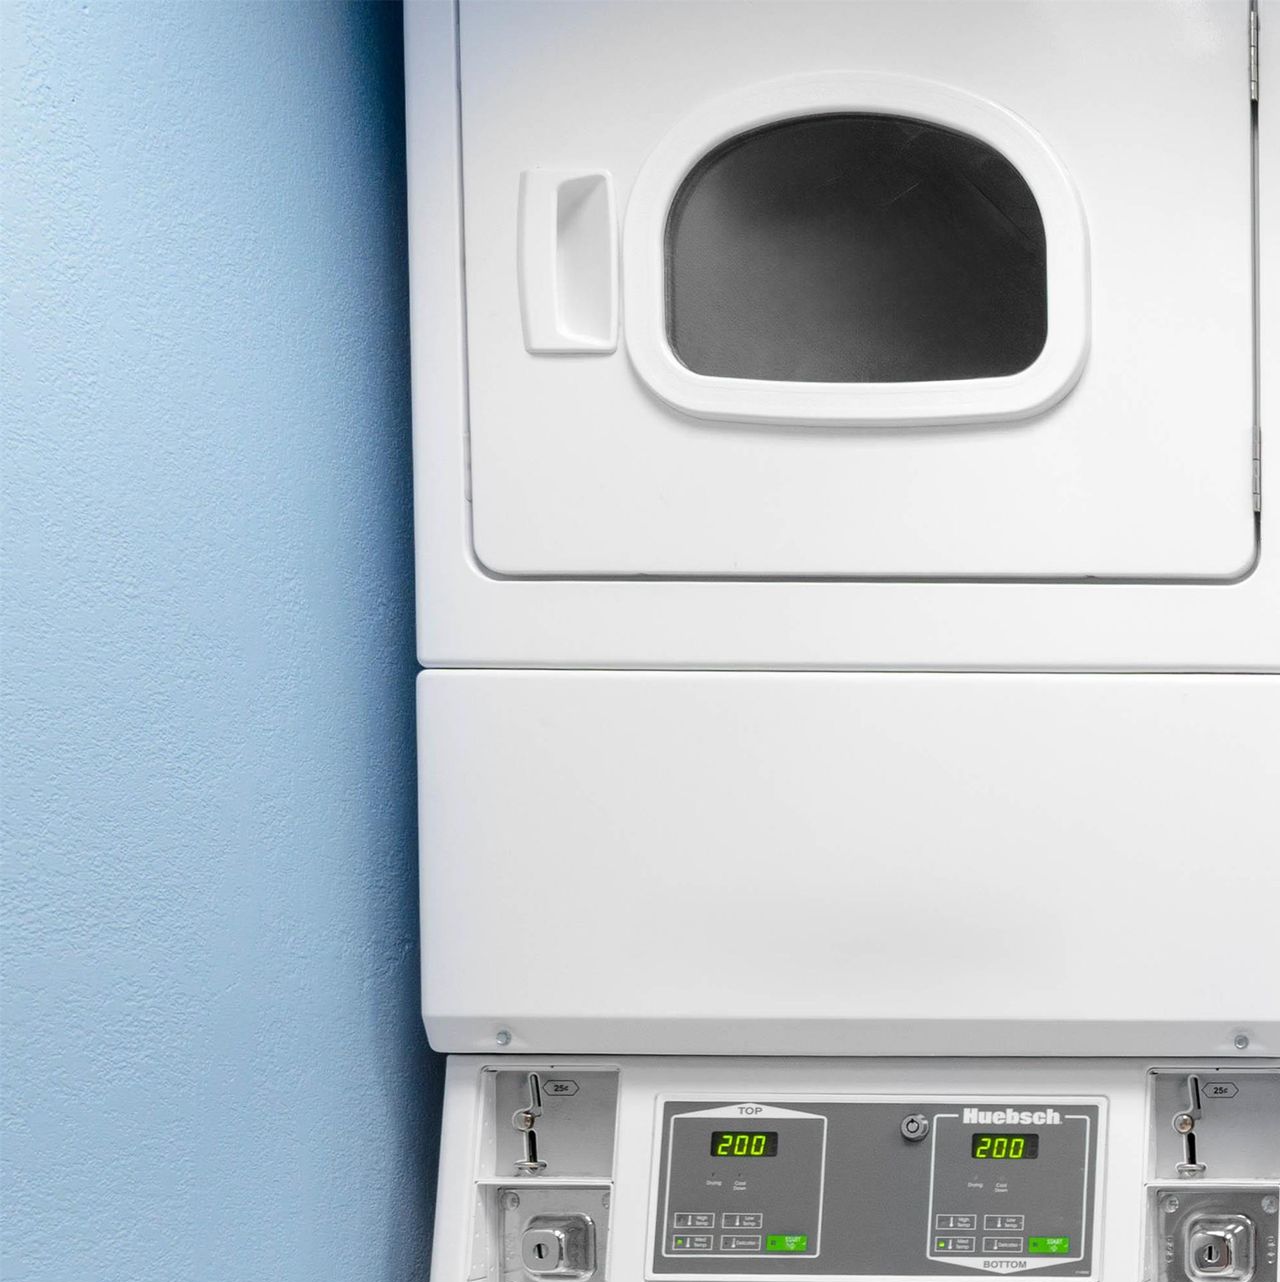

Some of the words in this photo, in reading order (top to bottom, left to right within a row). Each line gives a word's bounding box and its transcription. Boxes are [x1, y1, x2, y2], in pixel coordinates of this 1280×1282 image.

[738, 1106, 764, 1115] TOP
[963, 1108, 1061, 1125] Huebsch
[717, 1135, 767, 1156] 200
[975, 1137, 1025, 1158] 200
[983, 1260, 1027, 1269] BOTTOM
